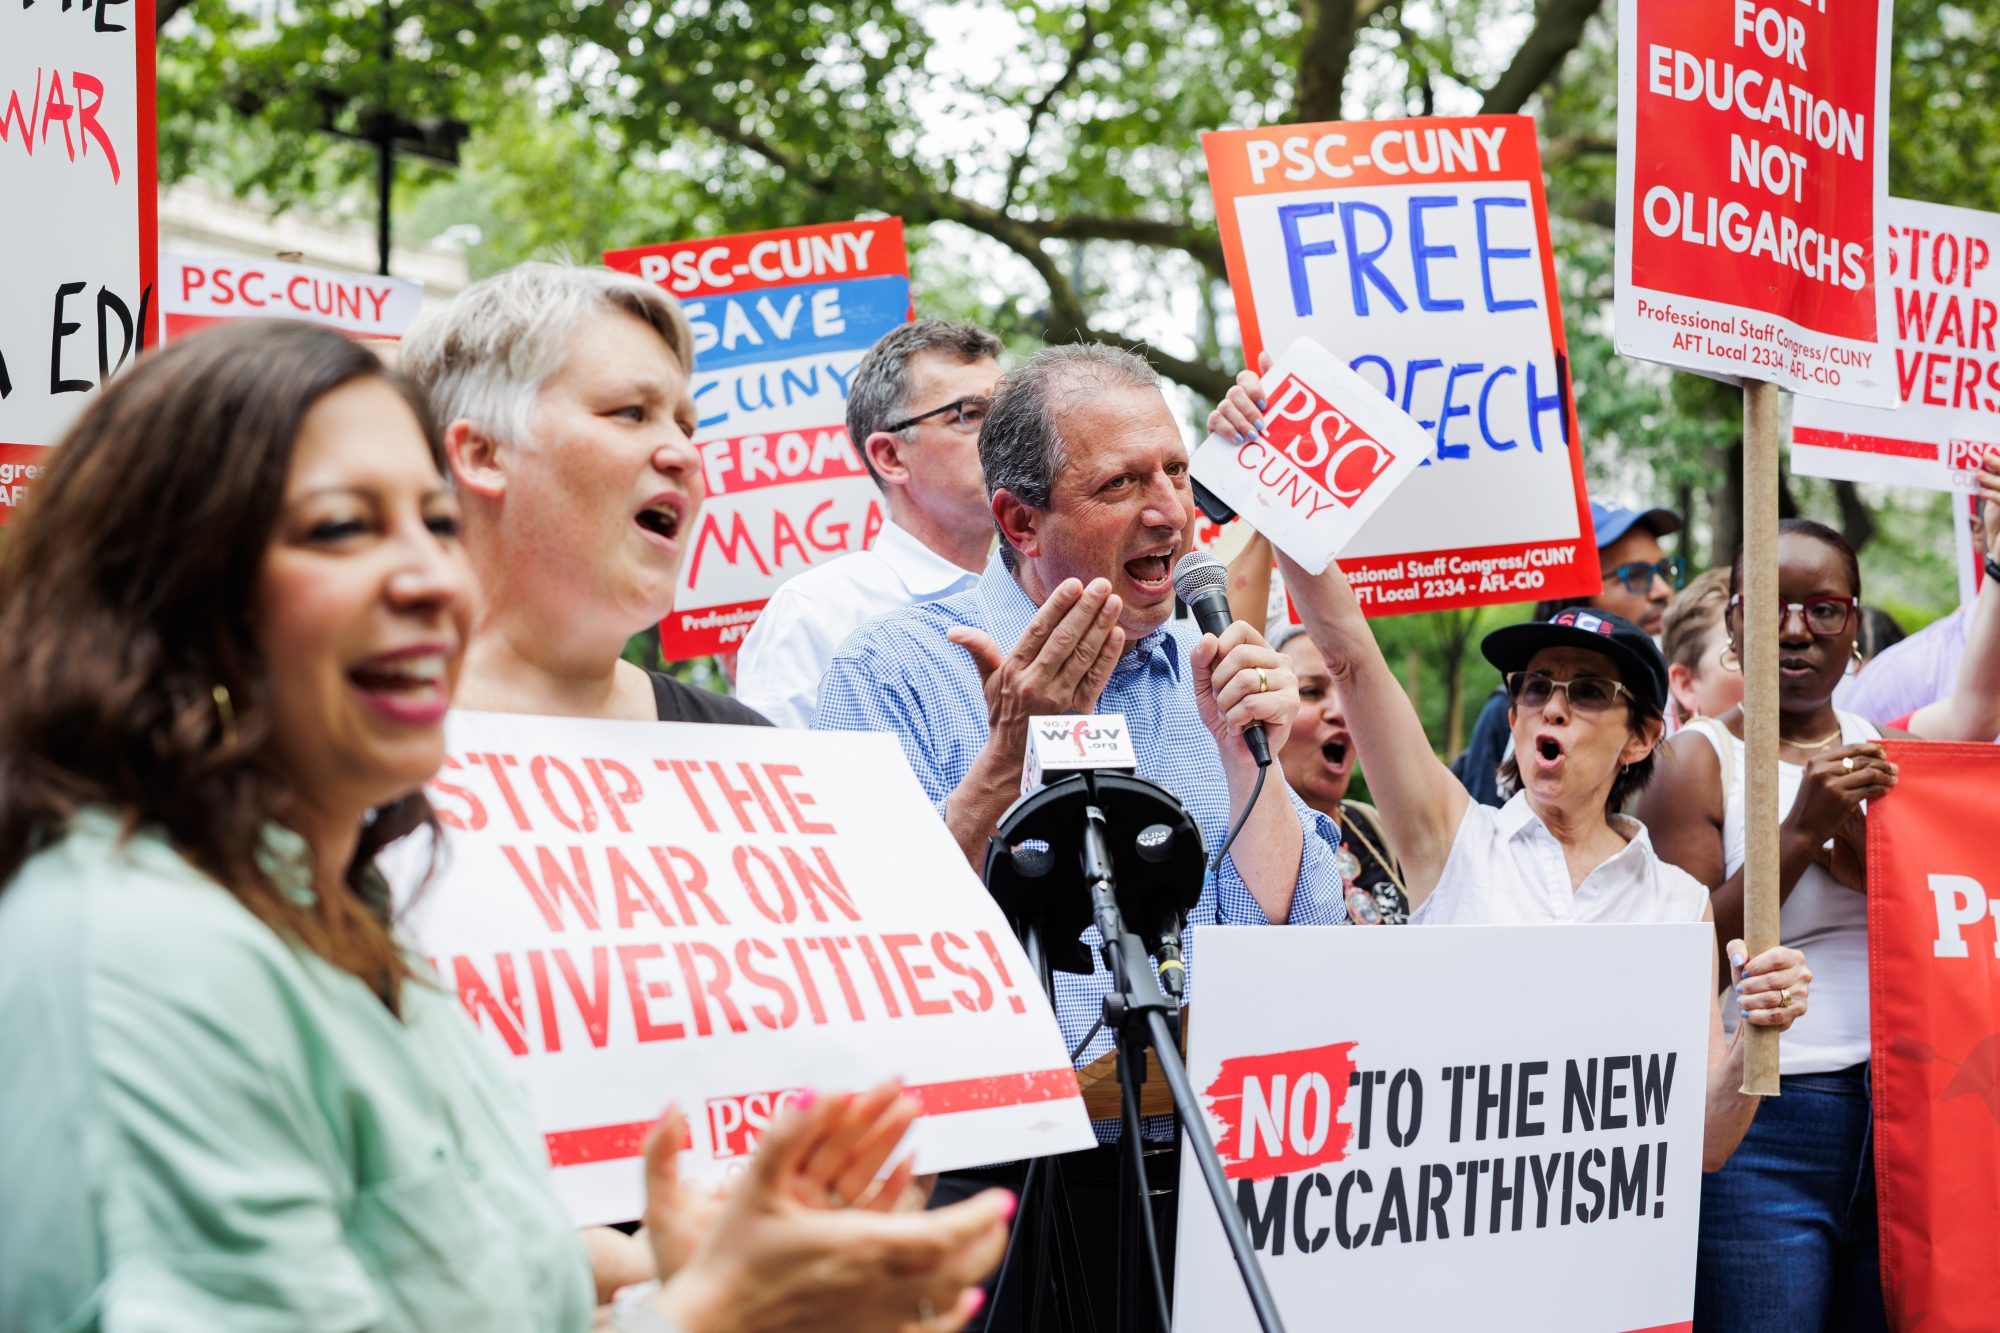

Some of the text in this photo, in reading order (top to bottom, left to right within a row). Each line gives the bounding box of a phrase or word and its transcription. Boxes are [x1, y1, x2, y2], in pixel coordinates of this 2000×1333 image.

[1734, 0, 1807, 71] FOR
[0, 67, 121, 186] WAR
[1650, 44, 1864, 161] EDUCATION
[1246, 127, 1506, 184] PSC-CUNY
[1730, 133, 1807, 203] NOT
[640, 230, 875, 292] PSC-CUNY
[1278, 196, 1537, 317] FREE
[1643, 185, 1866, 290] OLIGARCHS
[181, 266, 392, 321] PSC-CUNY
[683, 288, 846, 351] SAVE
[1895, 287, 1999, 352] WAR
[1637, 299, 1873, 369] Professional Staff Congress/CUNY
[1672, 331, 1703, 353] AFT
[1707, 338, 1747, 362] Local
[1751, 346, 1784, 370] 2334
[1789, 362, 1841, 386] AFL-CIO
[700, 432, 861, 494] FROM
[1258, 376, 1391, 498] PSC
[1238, 441, 1334, 520] CUNY
[687, 499, 885, 590] MAGA
[1407, 556, 1447, 579] Staff
[1449, 546, 1576, 577] Congress/CUNY
[1354, 587, 1374, 605] FT
[1377, 577, 1420, 603] Local
[1423, 578, 1466, 598] 2334
[1479, 570, 1545, 594] AFL-CIO
[431, 752, 838, 835] STOP THE
[500, 844, 862, 931] WAR ON
[430, 929, 1027, 1056] NIVERSITIES!
[1239, 1052, 1677, 1159] NO TO THE NEW
[1235, 1141, 1668, 1256] MCCARTHYISM!
